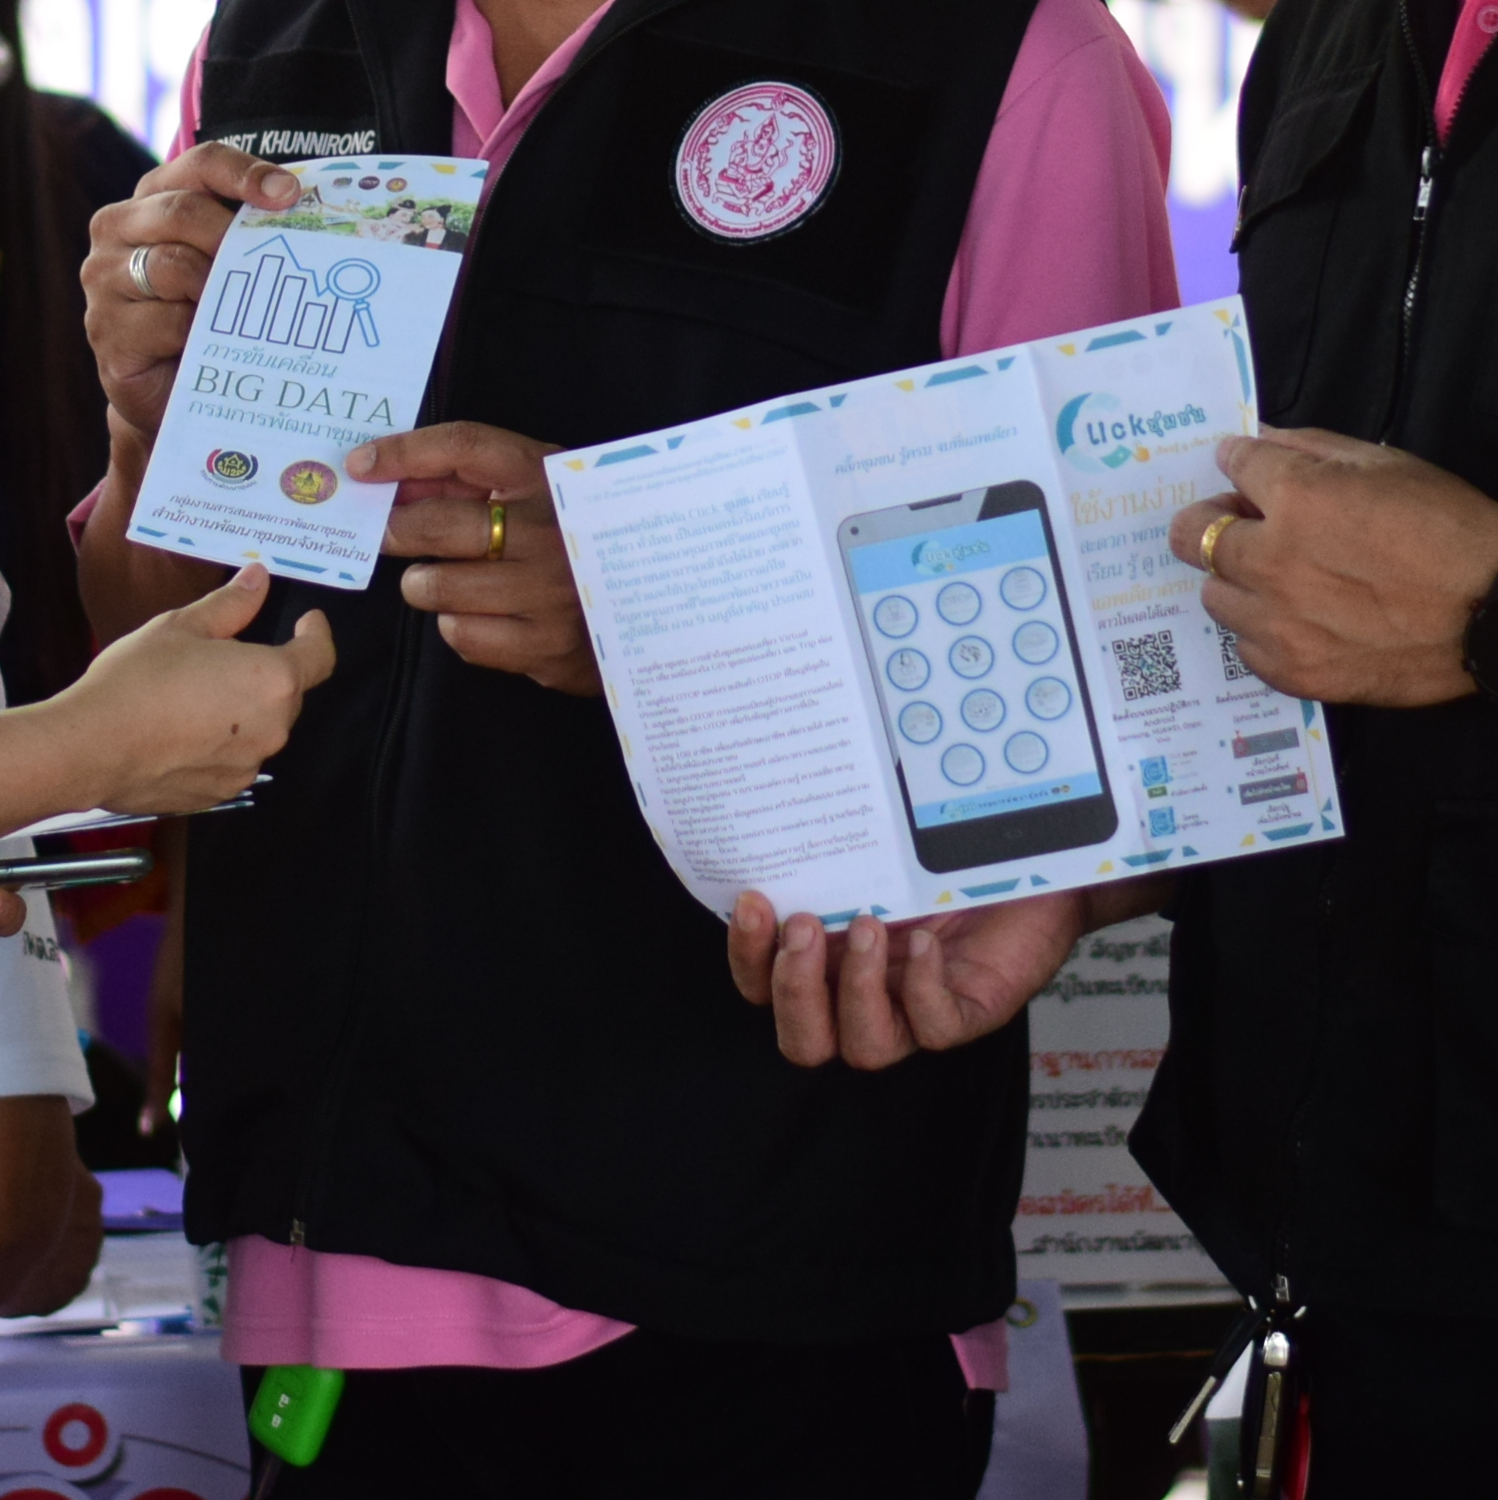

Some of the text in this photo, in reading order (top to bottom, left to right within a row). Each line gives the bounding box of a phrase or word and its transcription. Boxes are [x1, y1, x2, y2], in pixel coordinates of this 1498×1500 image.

[215, 129, 377, 156] NSIT KHUNNIRONG
[202, 342, 338, 378] การขับเคลื่อน
[191, 364, 395, 427] BIG DATA
[688, 504, 718, 518] Click
[1070, 477, 1194, 525] ใช้งานง่าย
[1131, 526, 1165, 542] พกพ
[1143, 715, 1175, 726] Android
